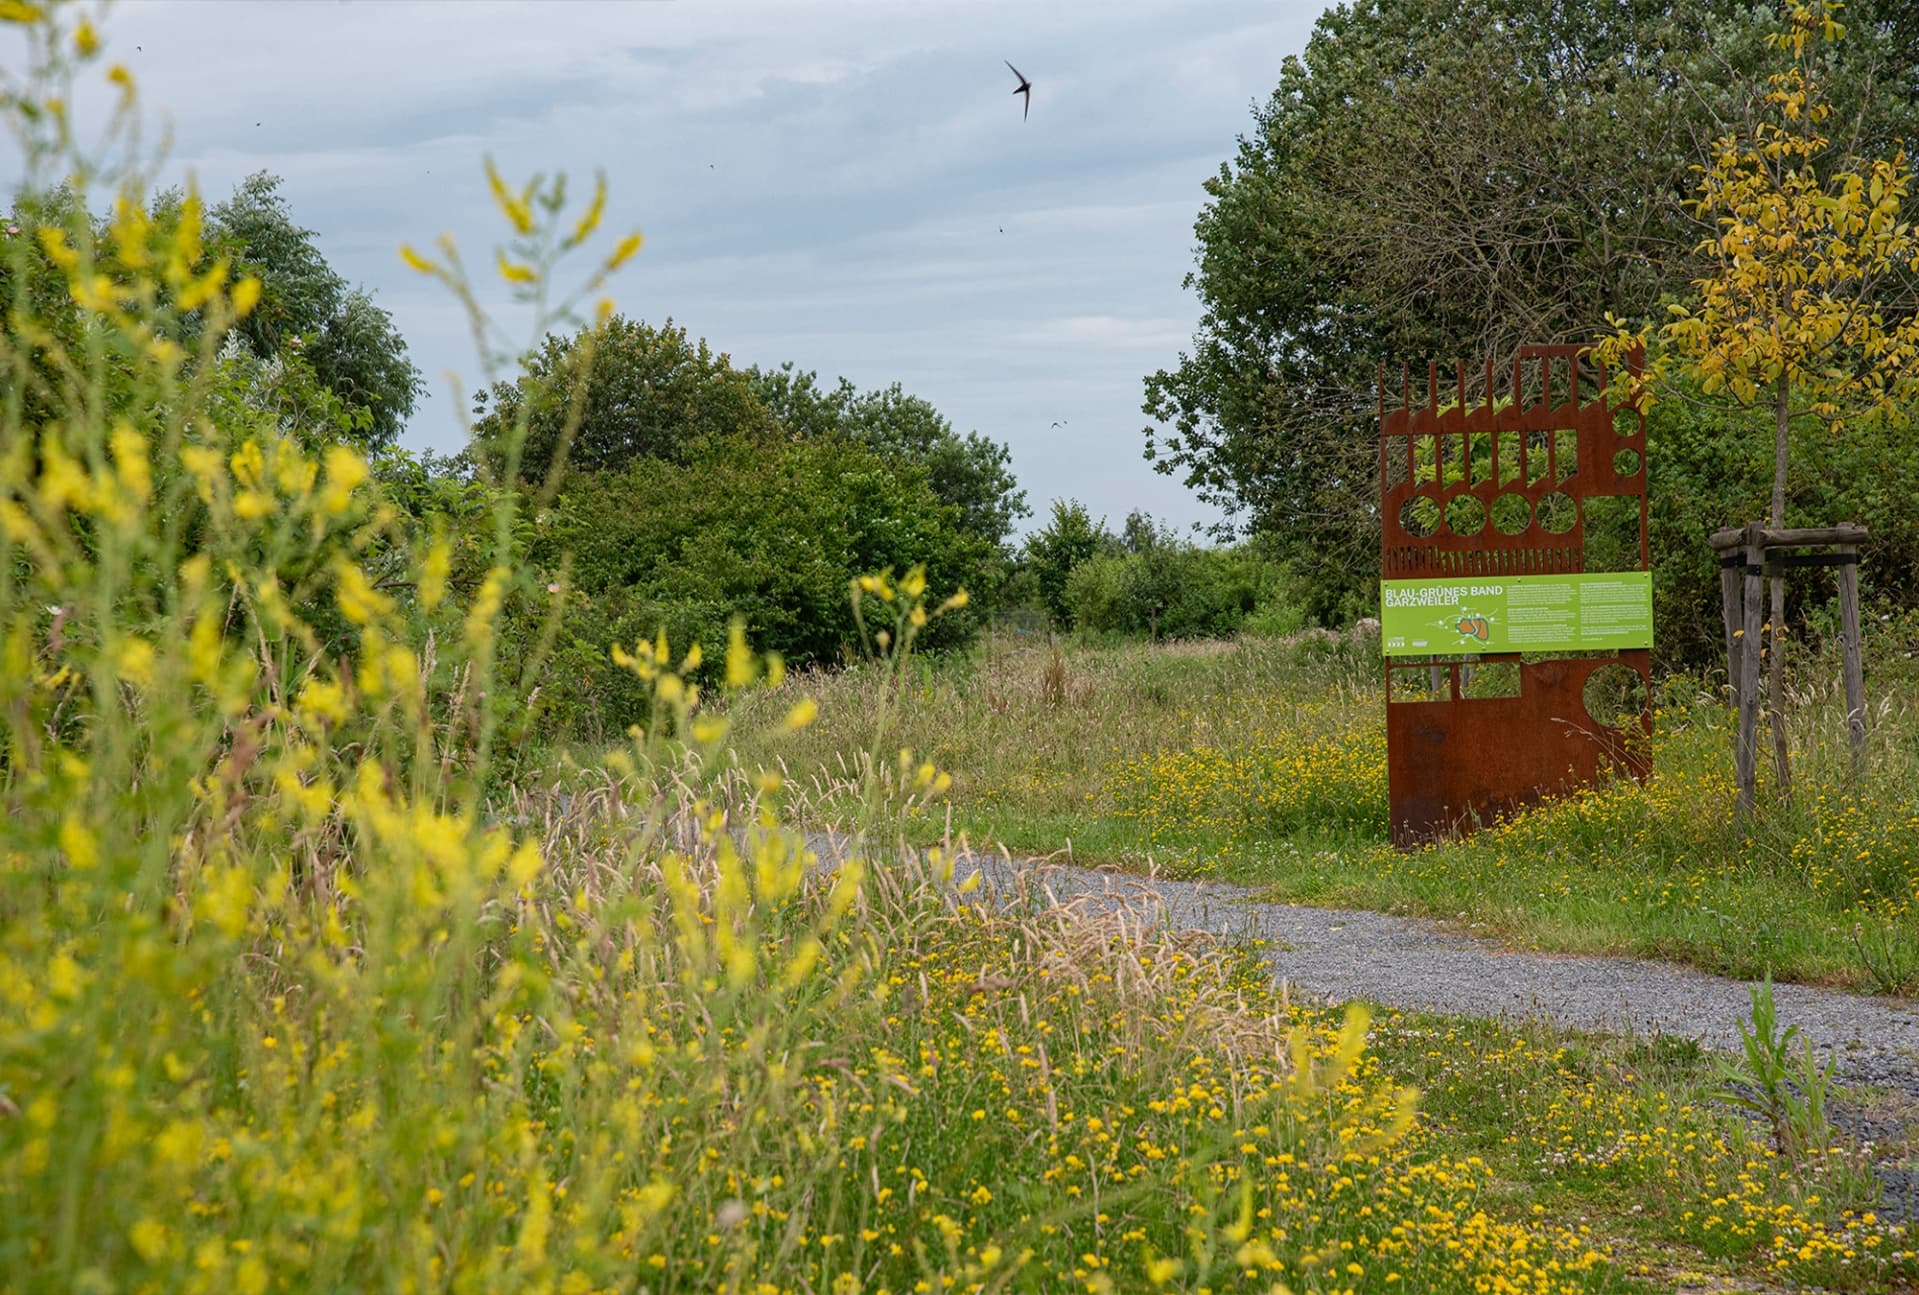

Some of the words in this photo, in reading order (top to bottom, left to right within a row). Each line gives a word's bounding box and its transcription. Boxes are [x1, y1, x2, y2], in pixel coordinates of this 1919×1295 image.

[1385, 585, 1468, 598] BLAU-GRÜNES
[1471, 586, 1503, 596] BAND
[1385, 596, 1459, 607] GARZWEILER
